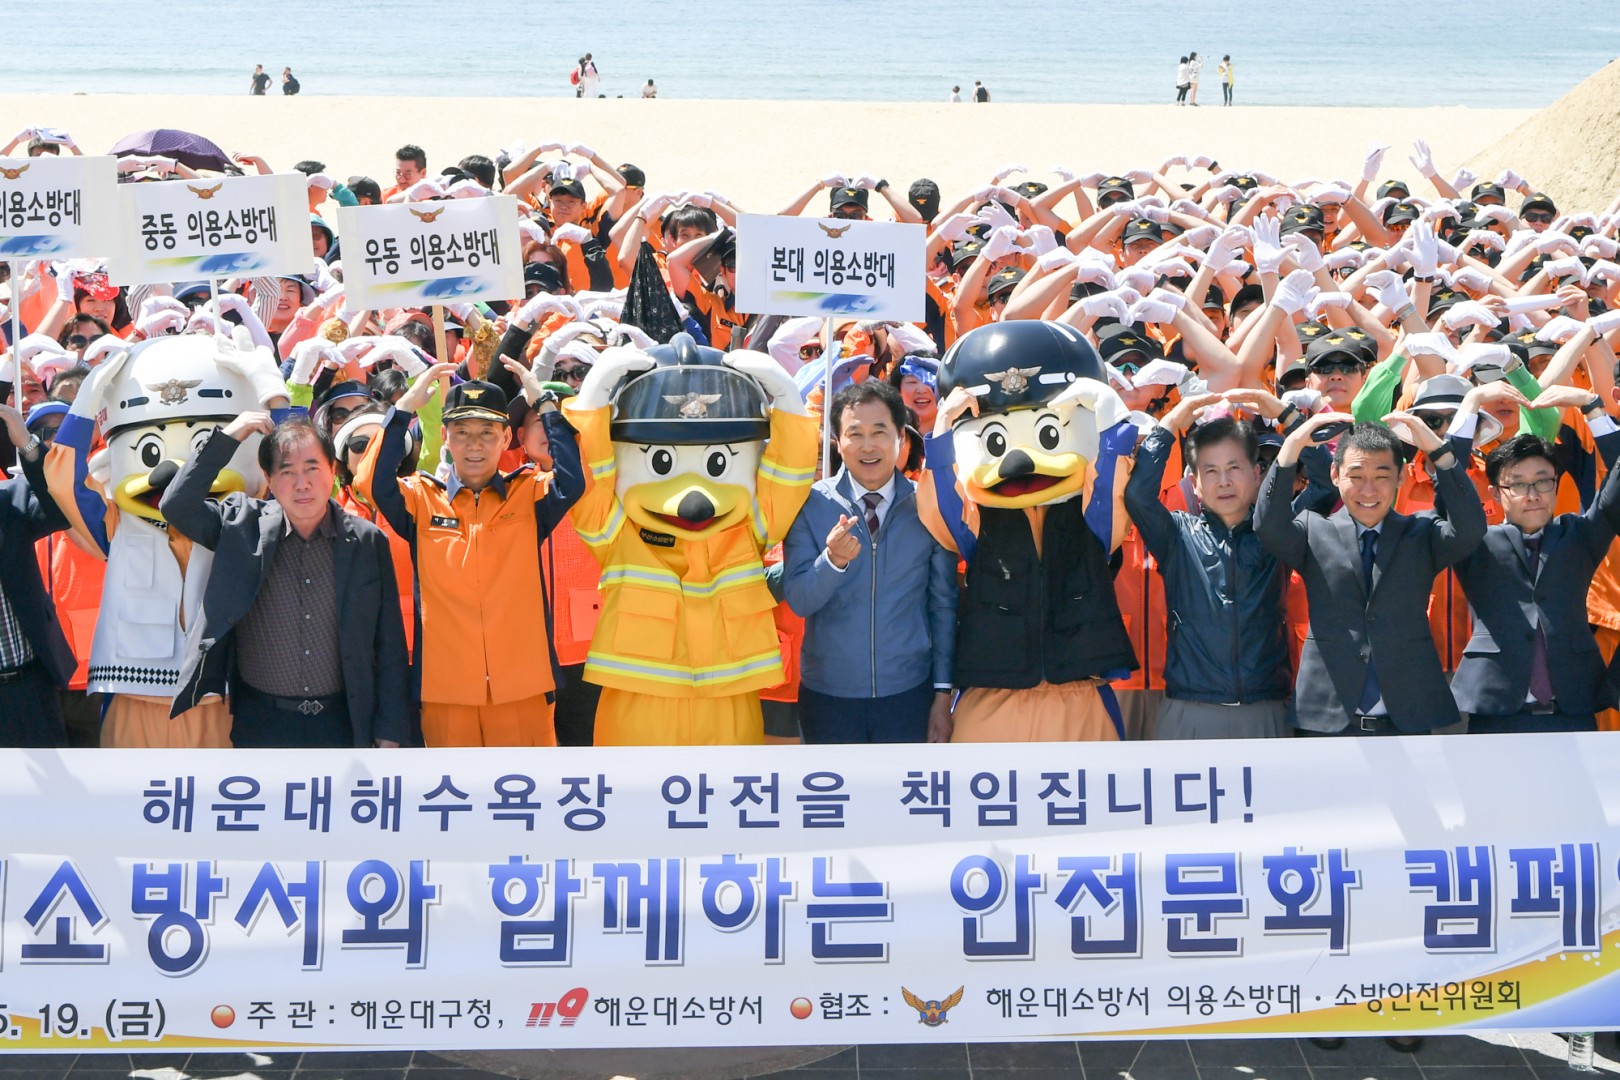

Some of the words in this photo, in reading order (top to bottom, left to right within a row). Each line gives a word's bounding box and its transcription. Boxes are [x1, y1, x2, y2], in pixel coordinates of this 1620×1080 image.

[141, 213, 178, 251] 중동
[187, 206, 277, 247] 의용소방대
[365, 237, 401, 276] 우동
[410, 228, 500, 272] 의용소방대
[771, 246, 804, 284] 본대
[813, 248, 895, 289] 의용소방대
[142, 774, 613, 833] 해운대해수욕장
[661, 771, 850, 829] 안전을
[900, 766, 1254, 828] 책임집니다!
[0, 859, 442, 978] 소방서와
[488, 853, 895, 969] 함께하는
[949, 846, 1363, 958] 안전문화
[1404, 841, 1620, 956] 캠페
[38, 1003, 88, 1036] 19.
[105, 998, 166, 1038] (금)
[350, 998, 503, 1030] 해운대구청,
[524, 986, 590, 1028] 119
[594, 995, 762, 1027] 해운대소방서
[986, 986, 1149, 1018] 해운대소방서
[1167, 984, 1301, 1016] 의용소방대
[1334, 980, 1521, 1013] 소방안전위원회
